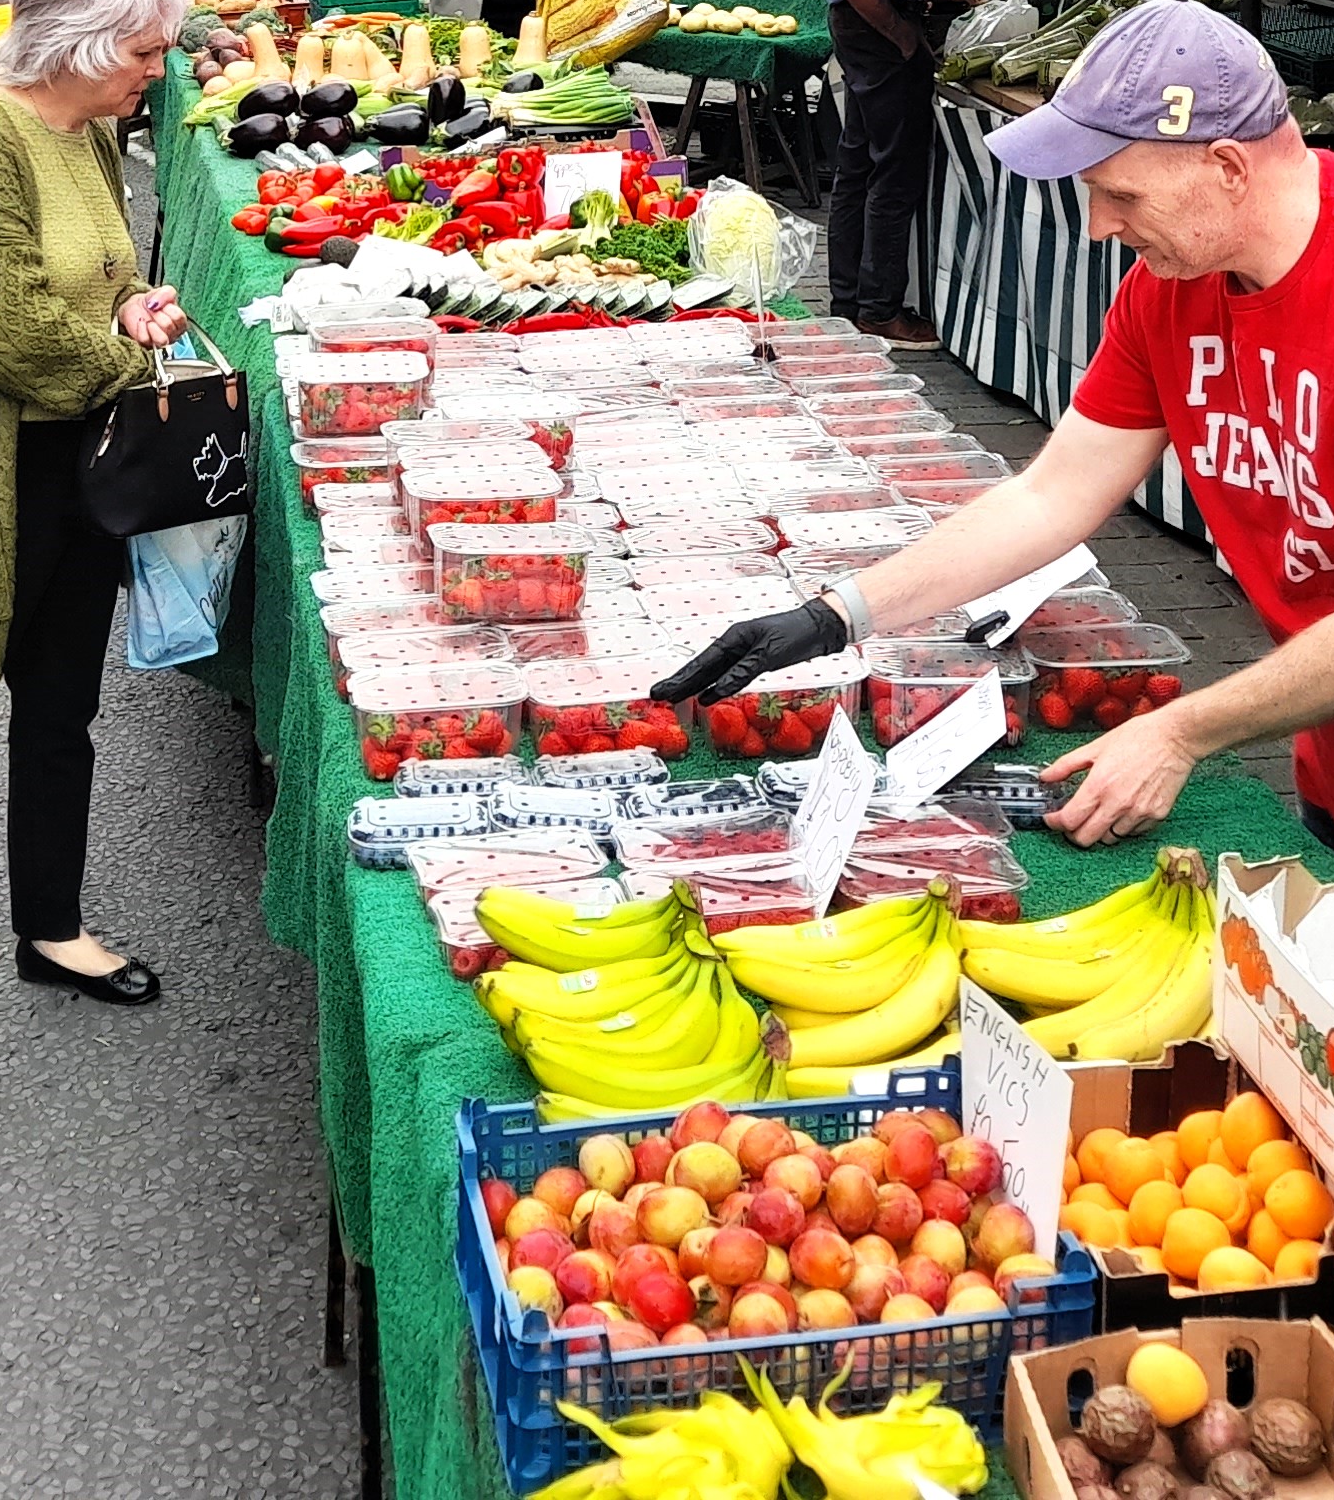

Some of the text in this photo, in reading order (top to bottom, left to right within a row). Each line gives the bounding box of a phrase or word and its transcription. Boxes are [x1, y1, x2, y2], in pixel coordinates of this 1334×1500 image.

[1157, 85, 1194, 136] 3
[1186, 335, 1319, 453] PLO
[964, 990, 1049, 1088] ENGLISH
